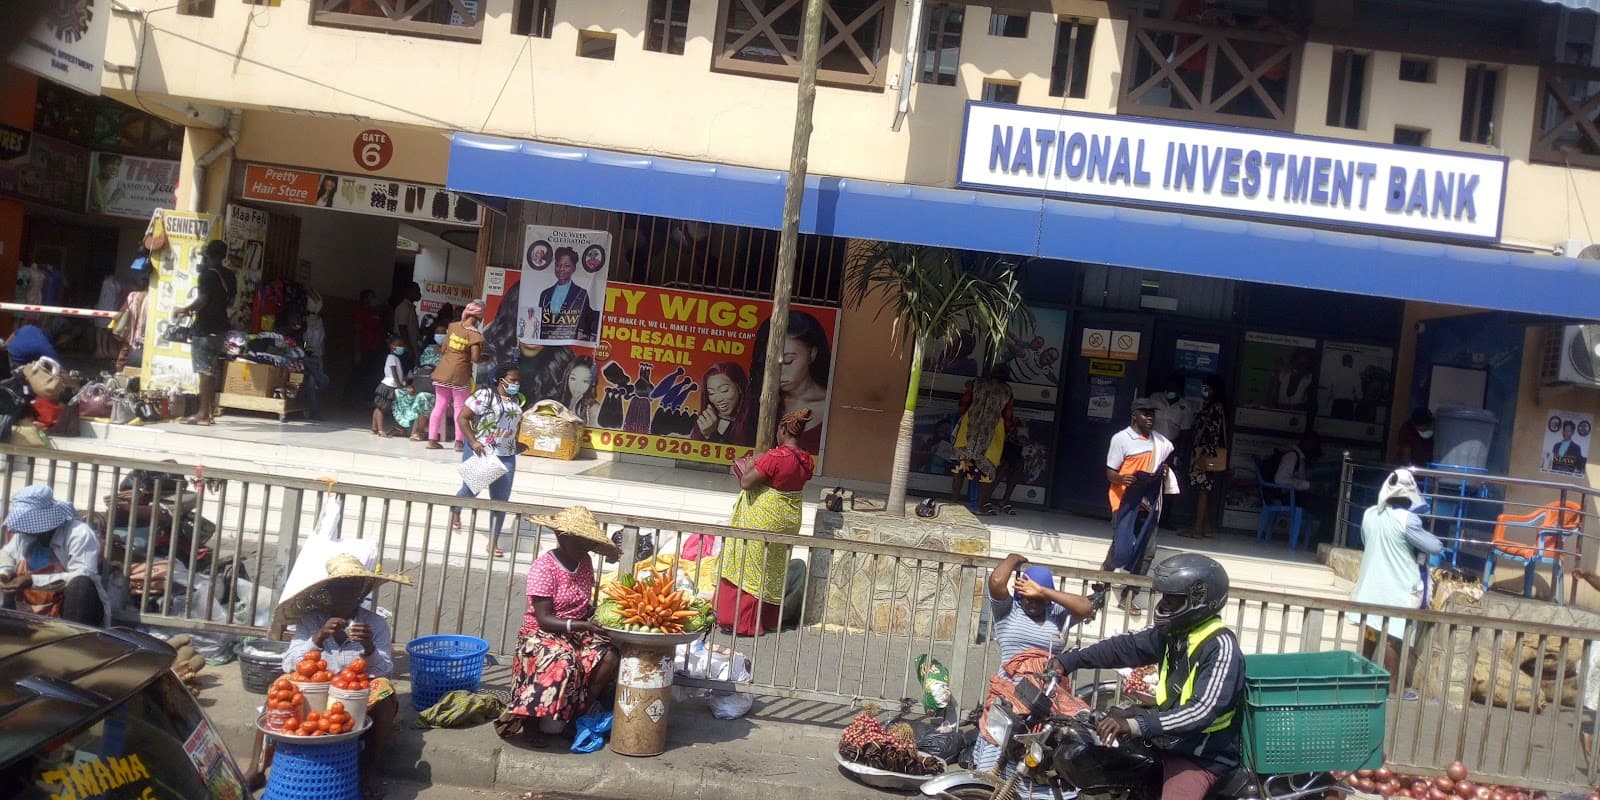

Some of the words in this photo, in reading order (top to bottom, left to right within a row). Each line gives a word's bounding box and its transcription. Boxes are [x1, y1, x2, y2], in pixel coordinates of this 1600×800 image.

[362, 133, 387, 144] GATE
[361, 143, 382, 167] 6
[264, 168, 299, 184] Pretty
[988, 124, 1151, 187] NATIONAL
[1162, 141, 1378, 210] INVESTMENT
[1384, 165, 1482, 221] BANK
[252, 181, 277, 194] Hair
[277, 184, 308, 199] Store
[552, 230, 568, 238] ONE
[425, 282, 459, 297] CLARA'S
[541, 312, 579, 325] SIAW
[604, 287, 647, 315] TY
[659, 293, 758, 330] WIGS
[607, 315, 617, 323] WE
[619, 317, 637, 326] MAKE
[648, 320, 658, 328] WE
[669, 323, 689, 333] MAKE
[689, 325, 697, 334] IT
[697, 327, 709, 336] THE
[710, 328, 725, 337] BEST
[727, 330, 737, 338] WE
[602, 325, 696, 350] HOLESALE
[702, 338, 745, 356] AND
[630, 345, 692, 366] RETAIL
[600, 431, 649, 450] 0679
[655, 438, 736, 461] 020-818
